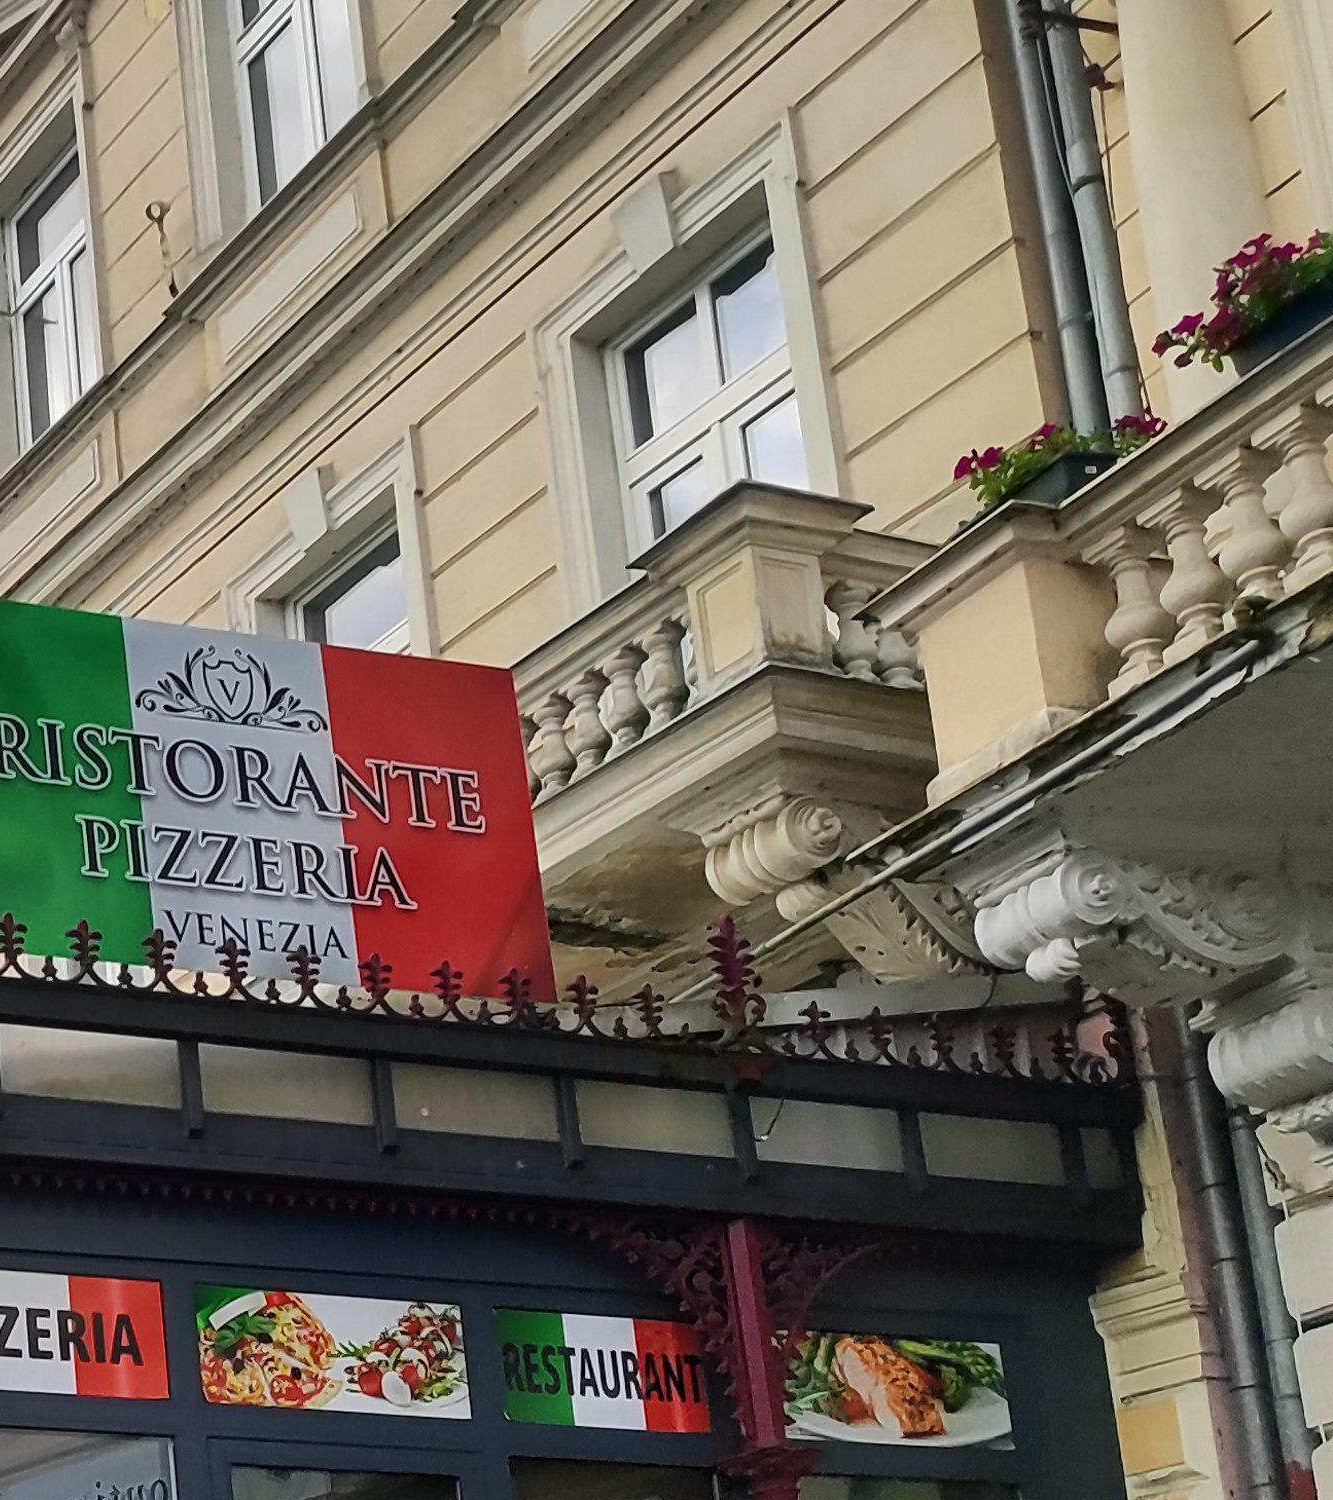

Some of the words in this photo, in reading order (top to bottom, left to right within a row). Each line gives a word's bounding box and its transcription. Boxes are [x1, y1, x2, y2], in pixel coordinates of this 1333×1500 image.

[75, 814, 418, 911] PIZZERIA
[162, 909, 349, 960] VENEZIA
[502, 1342, 701, 1404] RESTAURANT
